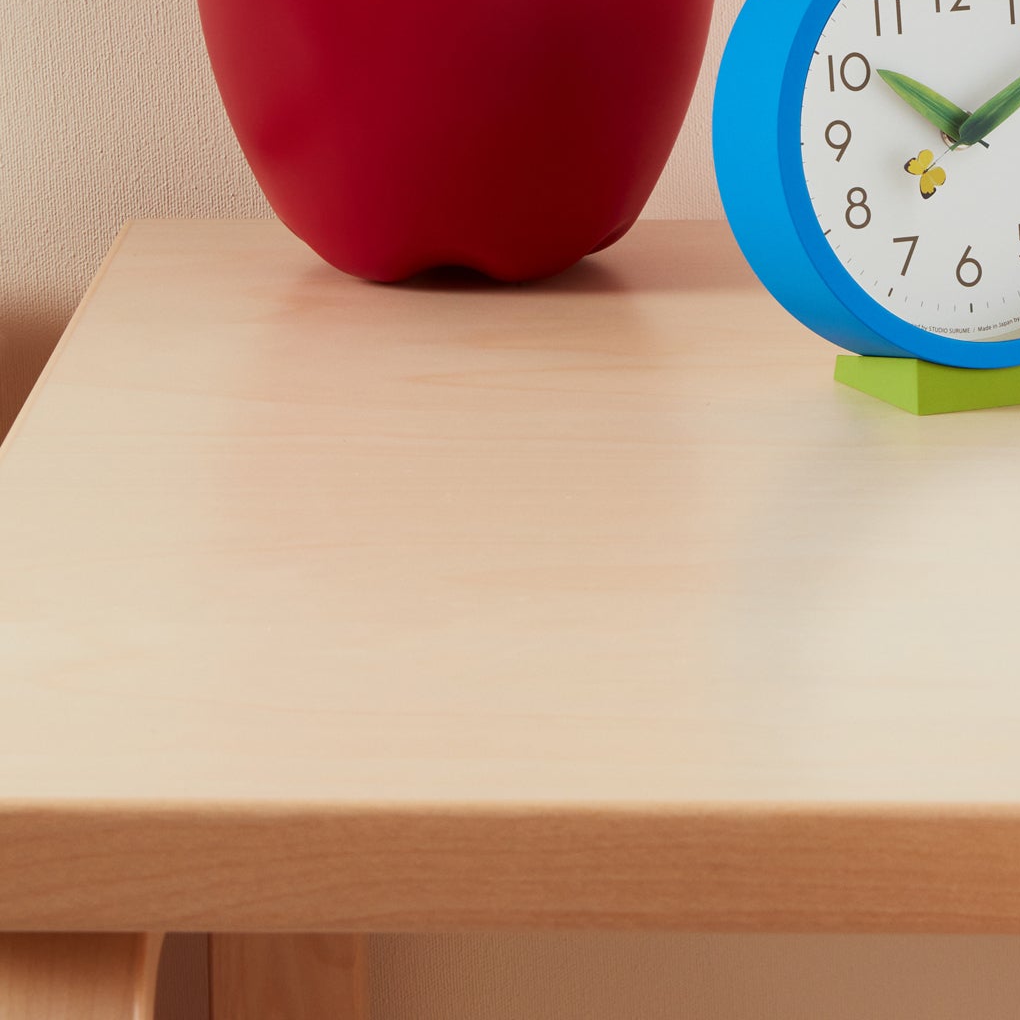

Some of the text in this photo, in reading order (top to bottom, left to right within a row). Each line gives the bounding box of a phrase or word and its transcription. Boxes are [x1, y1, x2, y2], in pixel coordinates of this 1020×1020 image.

[827, 52, 871, 92] 10
[824, 119, 852, 163] 9
[845, 186, 872, 230] 8
[892, 235, 920, 277] 7
[955, 245, 983, 288] 6
[929, 326, 949, 334] STUDIO
[977, 324, 992, 332] Made
[998, 319, 1014, 327] Japan
